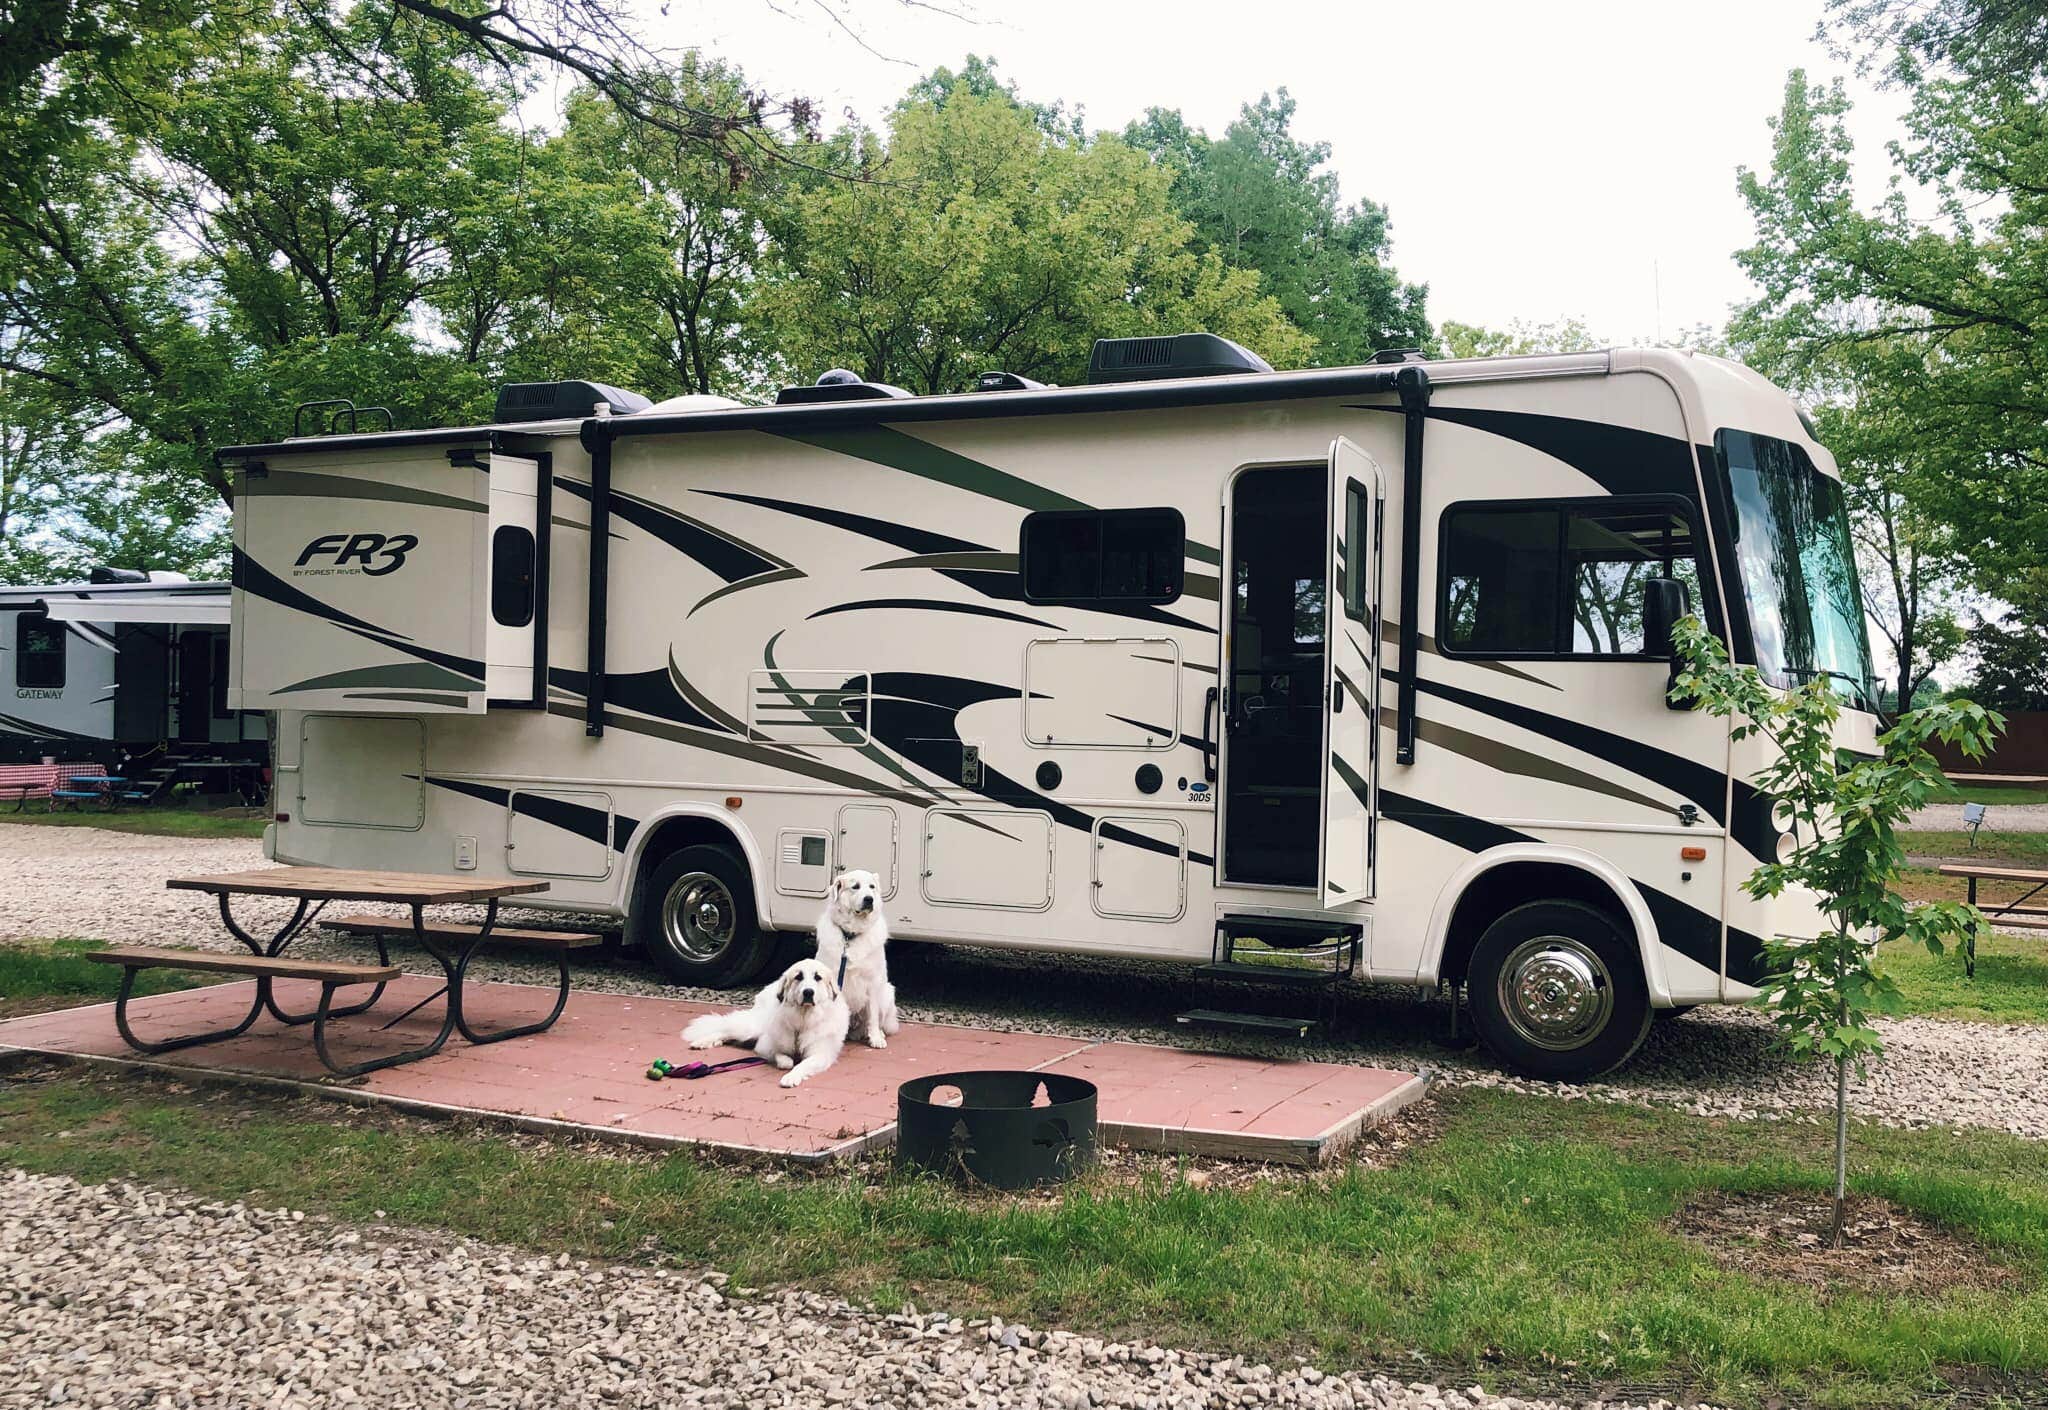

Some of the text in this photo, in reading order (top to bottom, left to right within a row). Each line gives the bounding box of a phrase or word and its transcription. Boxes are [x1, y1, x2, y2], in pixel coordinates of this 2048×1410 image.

[294, 533, 419, 576] FR3
[293, 569, 303, 577] BY
[336, 568, 361, 576] RIVER
[16, 688, 64, 700] GATEWAY
[1187, 792, 1212, 802] 30DS
